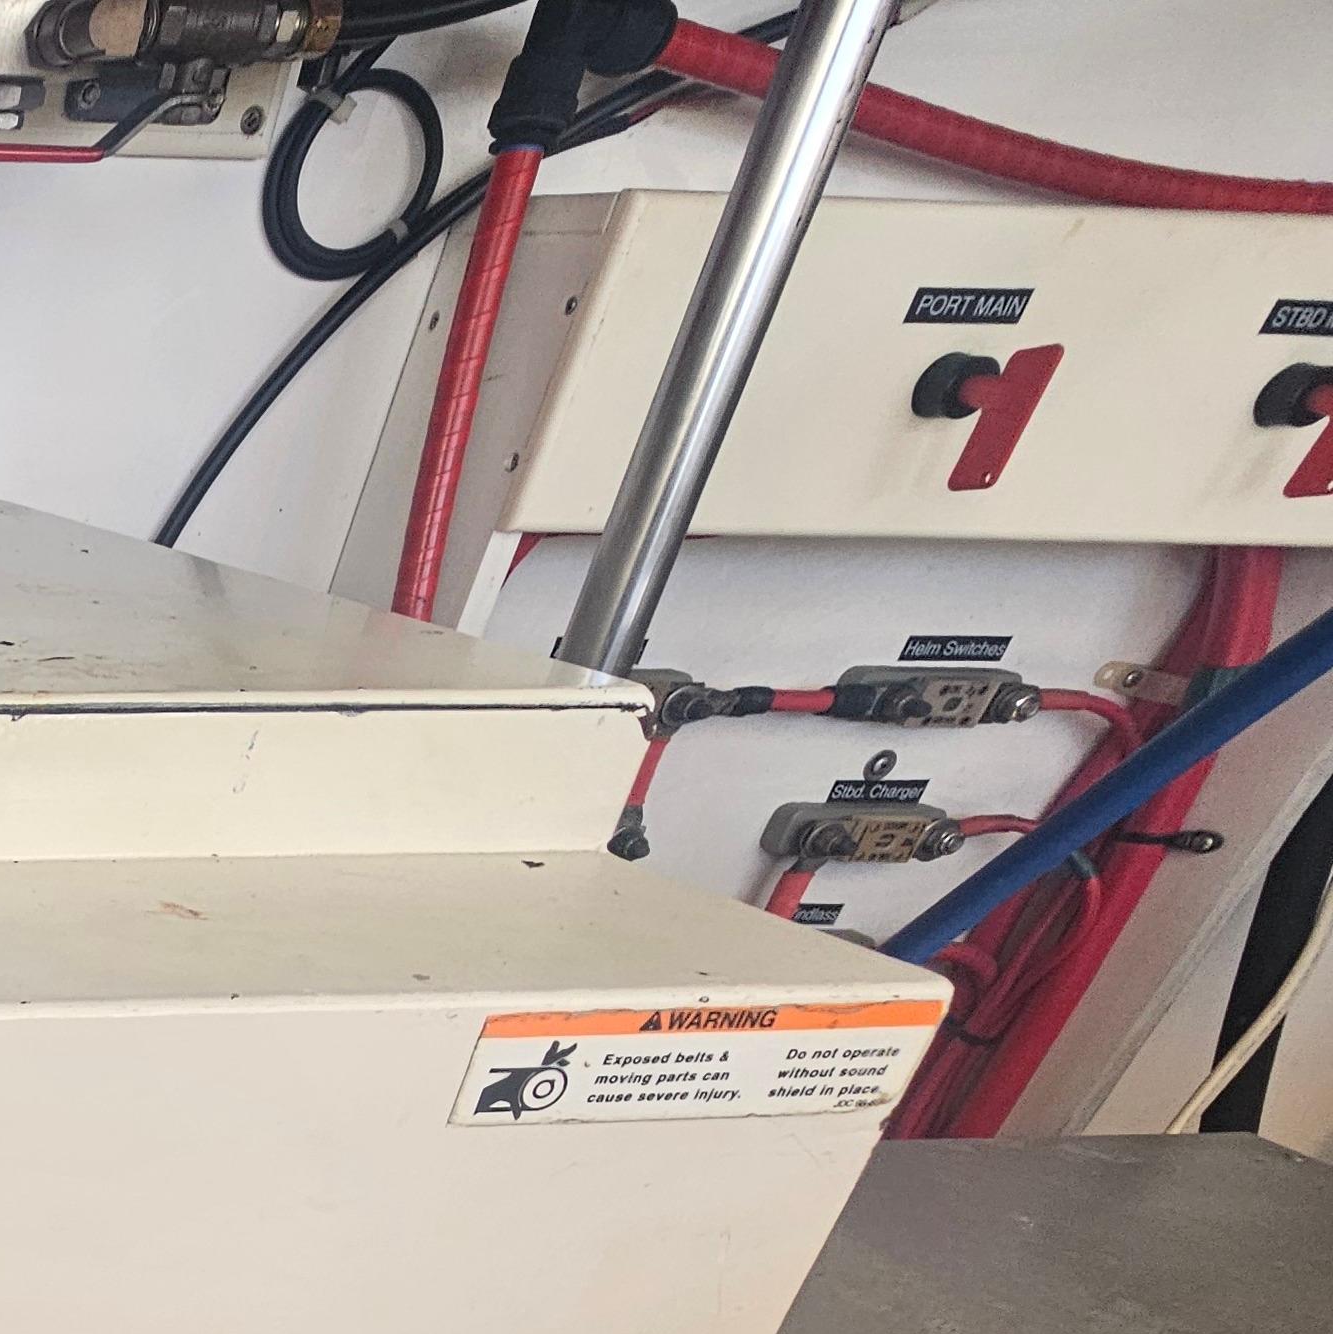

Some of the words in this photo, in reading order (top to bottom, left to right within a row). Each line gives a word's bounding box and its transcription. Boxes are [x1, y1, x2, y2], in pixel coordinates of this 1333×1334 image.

[916, 293, 972, 319] PORT
[972, 293, 1028, 318] MAIN
[1272, 305, 1327, 329] STBD
[904, 640, 940, 656] Helm
[943, 640, 1006, 657] Switches
[834, 784, 865, 798] Stbd.
[870, 784, 923, 800] Charger
[668, 1010, 779, 1030] WARNING
[603, 1052, 670, 1067] Exposed
[675, 1052, 713, 1063] belts
[719, 1051, 730, 1062] &
[786, 1049, 806, 1060] Do
[812, 1048, 838, 1059] not
[842, 1047, 901, 1061] operate
[594, 1073, 652, 1085] moving
[656, 1071, 697, 1085] parts
[702, 1071, 730, 1081] can
[777, 1067, 834, 1079] without
[839, 1064, 888, 1077] sound
[587, 1092, 633, 1103] cause
[637, 1091, 688, 1102] severe
[694, 1088, 741, 1102] injury.
[768, 1085, 816, 1098] shield
[820, 1085, 834, 1096] in
